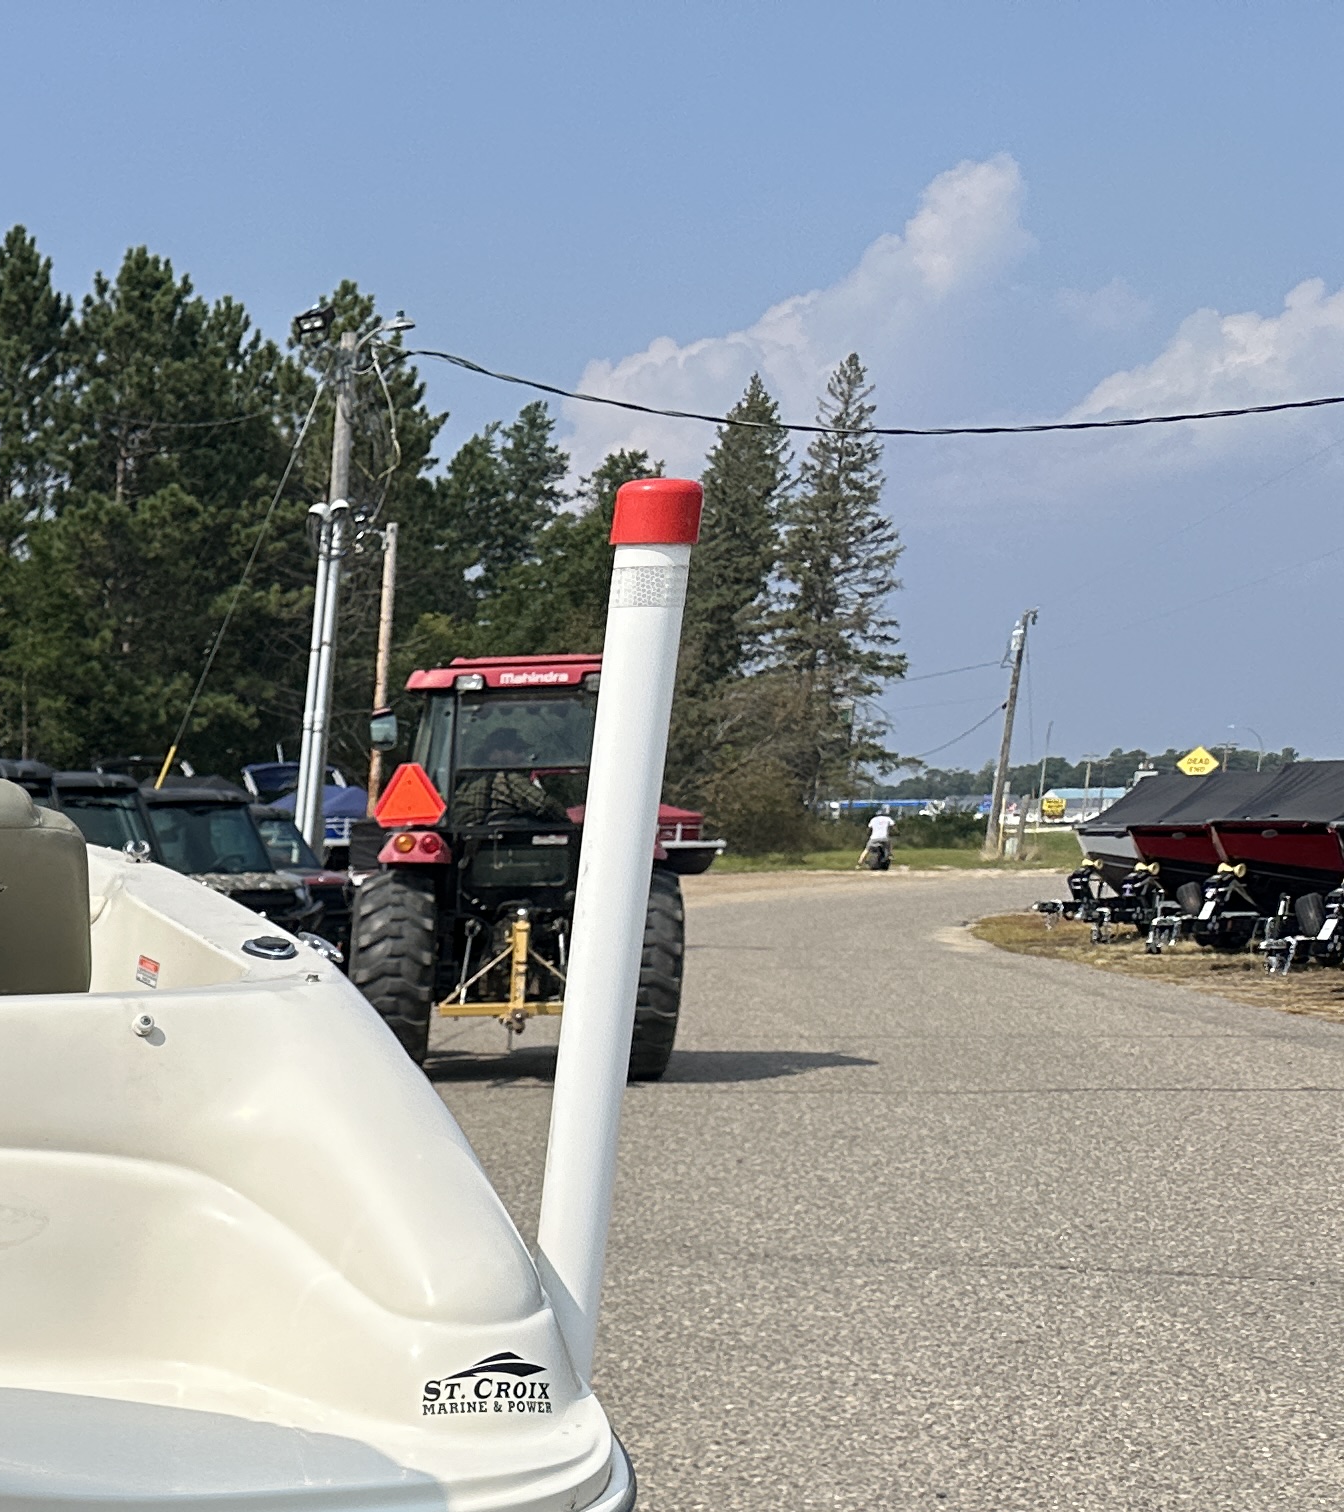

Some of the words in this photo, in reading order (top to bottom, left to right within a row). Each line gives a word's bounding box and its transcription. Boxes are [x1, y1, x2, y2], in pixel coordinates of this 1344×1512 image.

[499, 671, 569, 684] Mahindra
[423, 1380, 466, 1402] ST.
[474, 1378, 550, 1400] CROIX
[422, 1401, 487, 1415] MARINE
[493, 1401, 503, 1413] &
[507, 1401, 552, 1413] POWER
